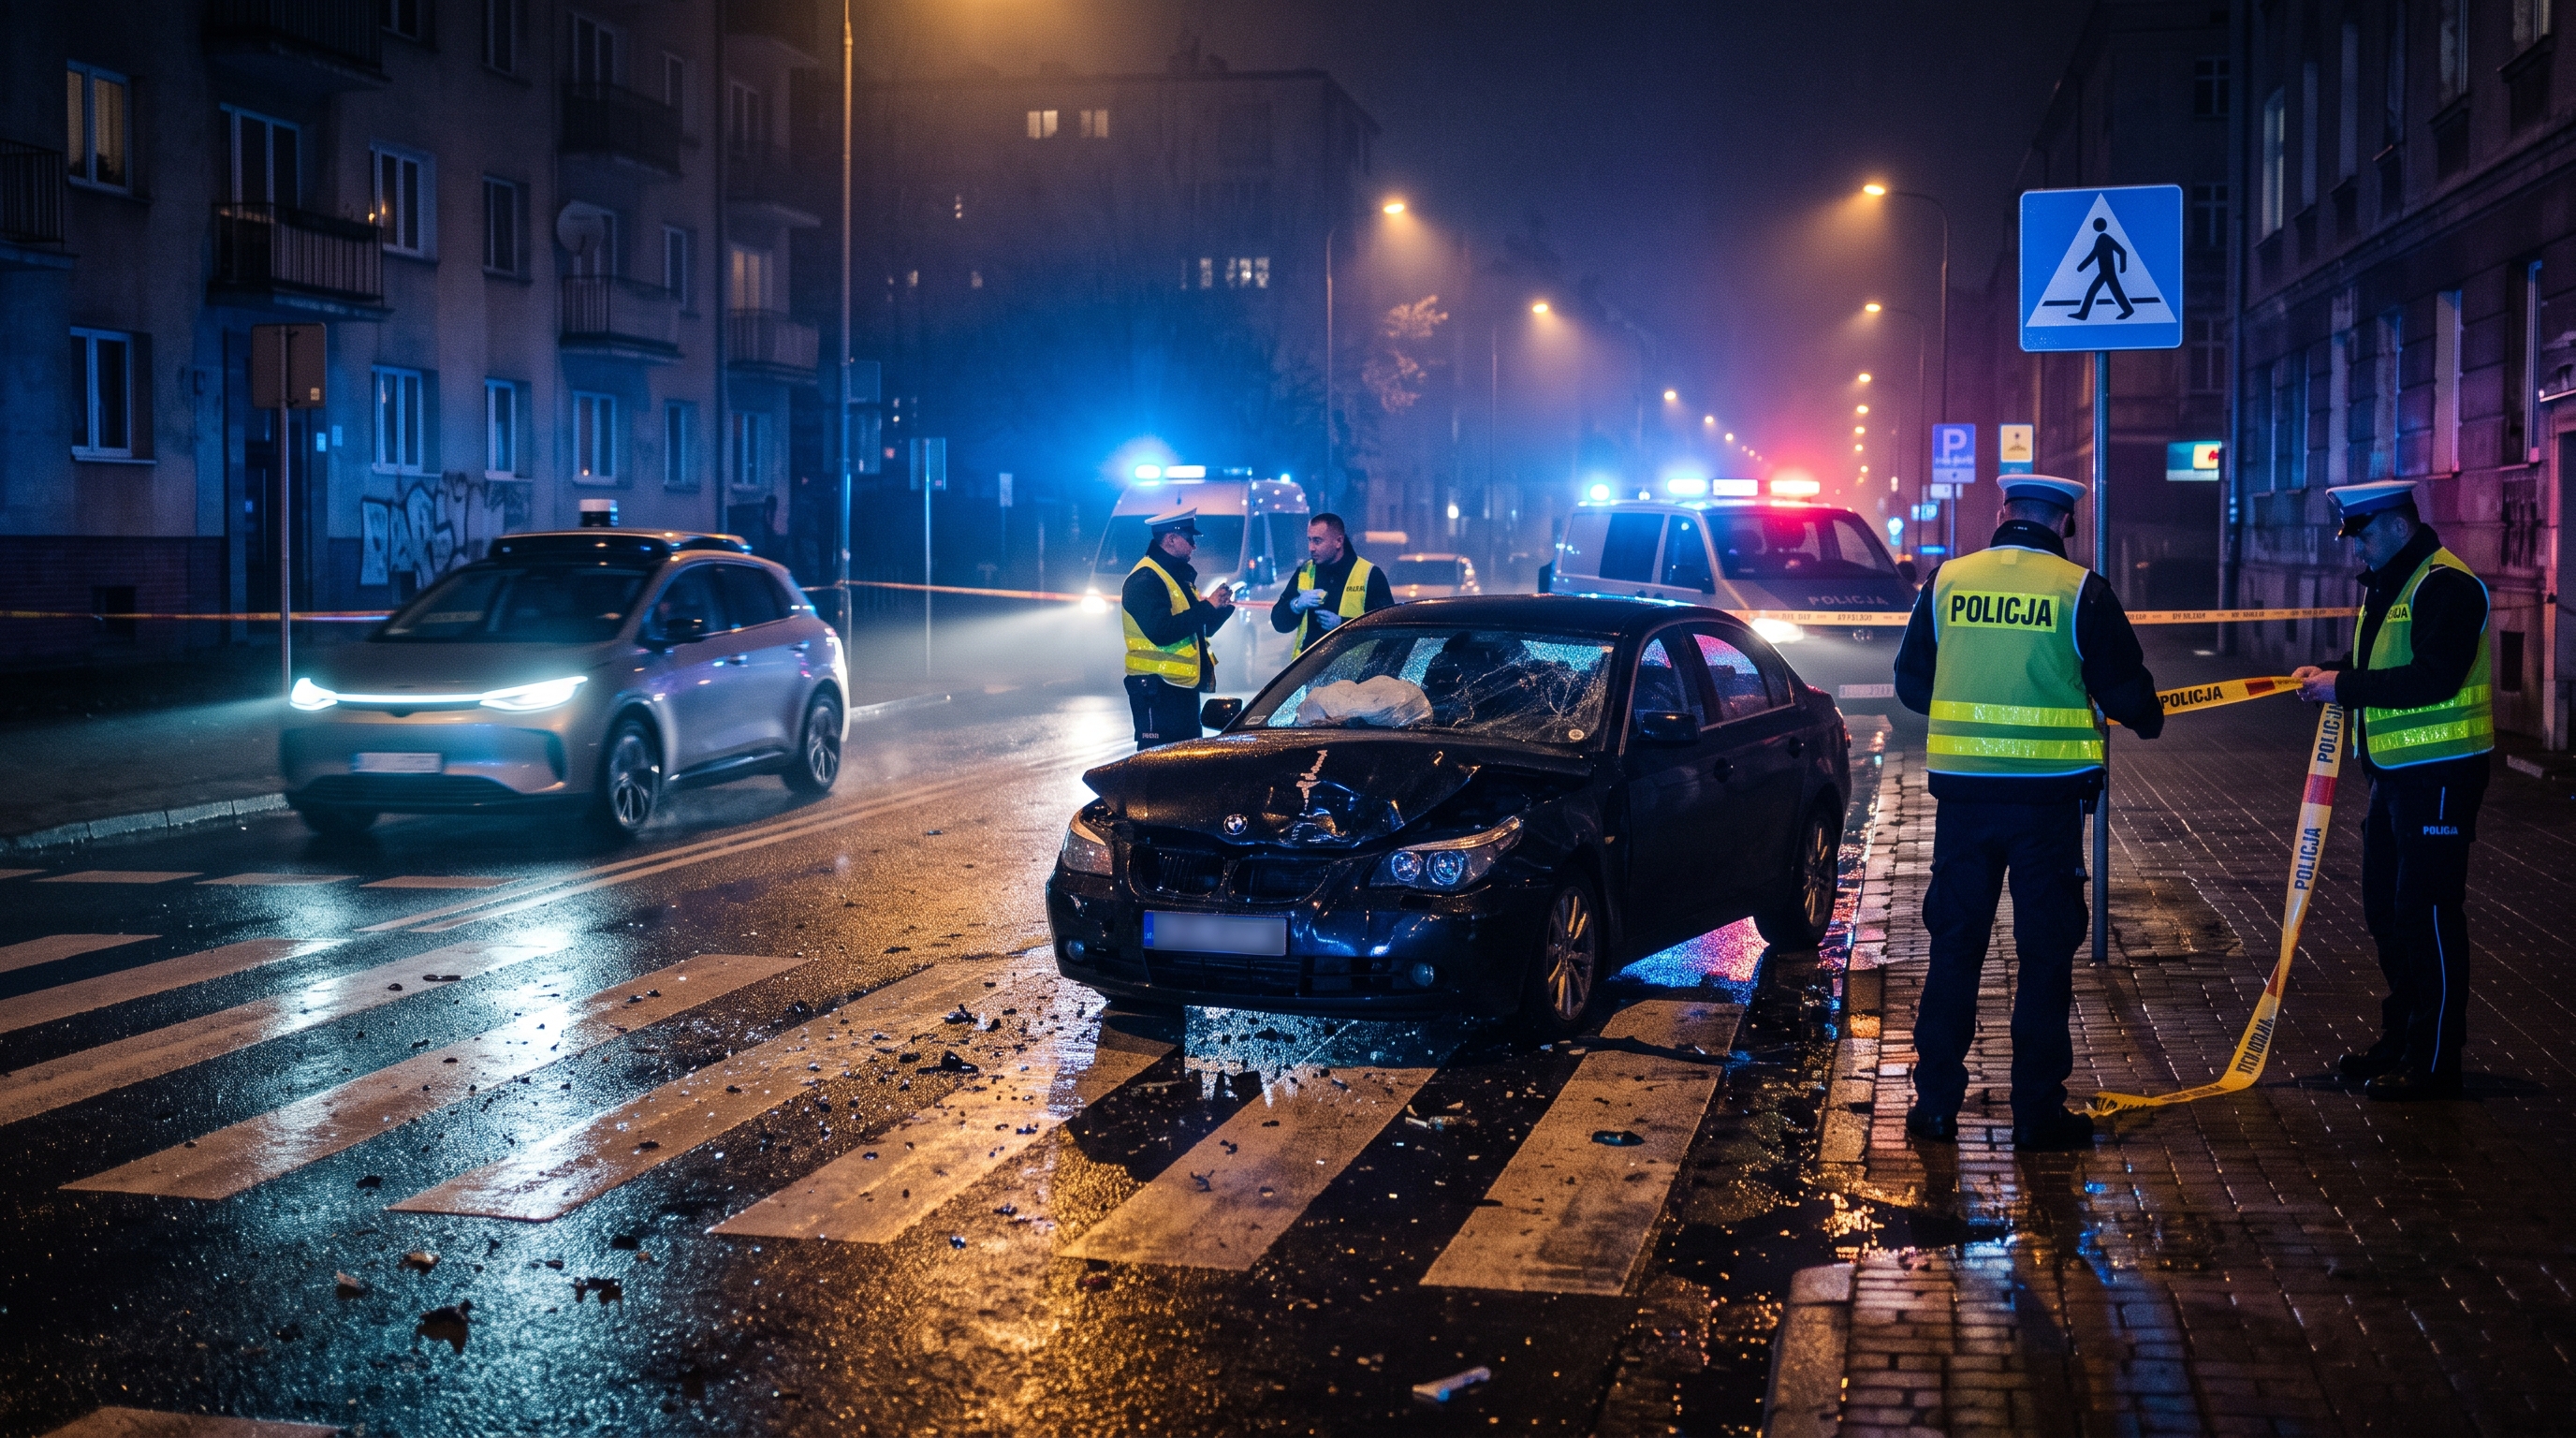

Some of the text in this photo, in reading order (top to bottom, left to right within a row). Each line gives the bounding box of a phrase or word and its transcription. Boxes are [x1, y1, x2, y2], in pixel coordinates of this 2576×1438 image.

[1942, 428, 1968, 457] P
[1808, 595, 1889, 606] POLICJA
[1951, 594, 2052, 627] POLICJA
[2160, 685, 2224, 709] POLICJA
[2294, 828, 2321, 890] POLICJA
